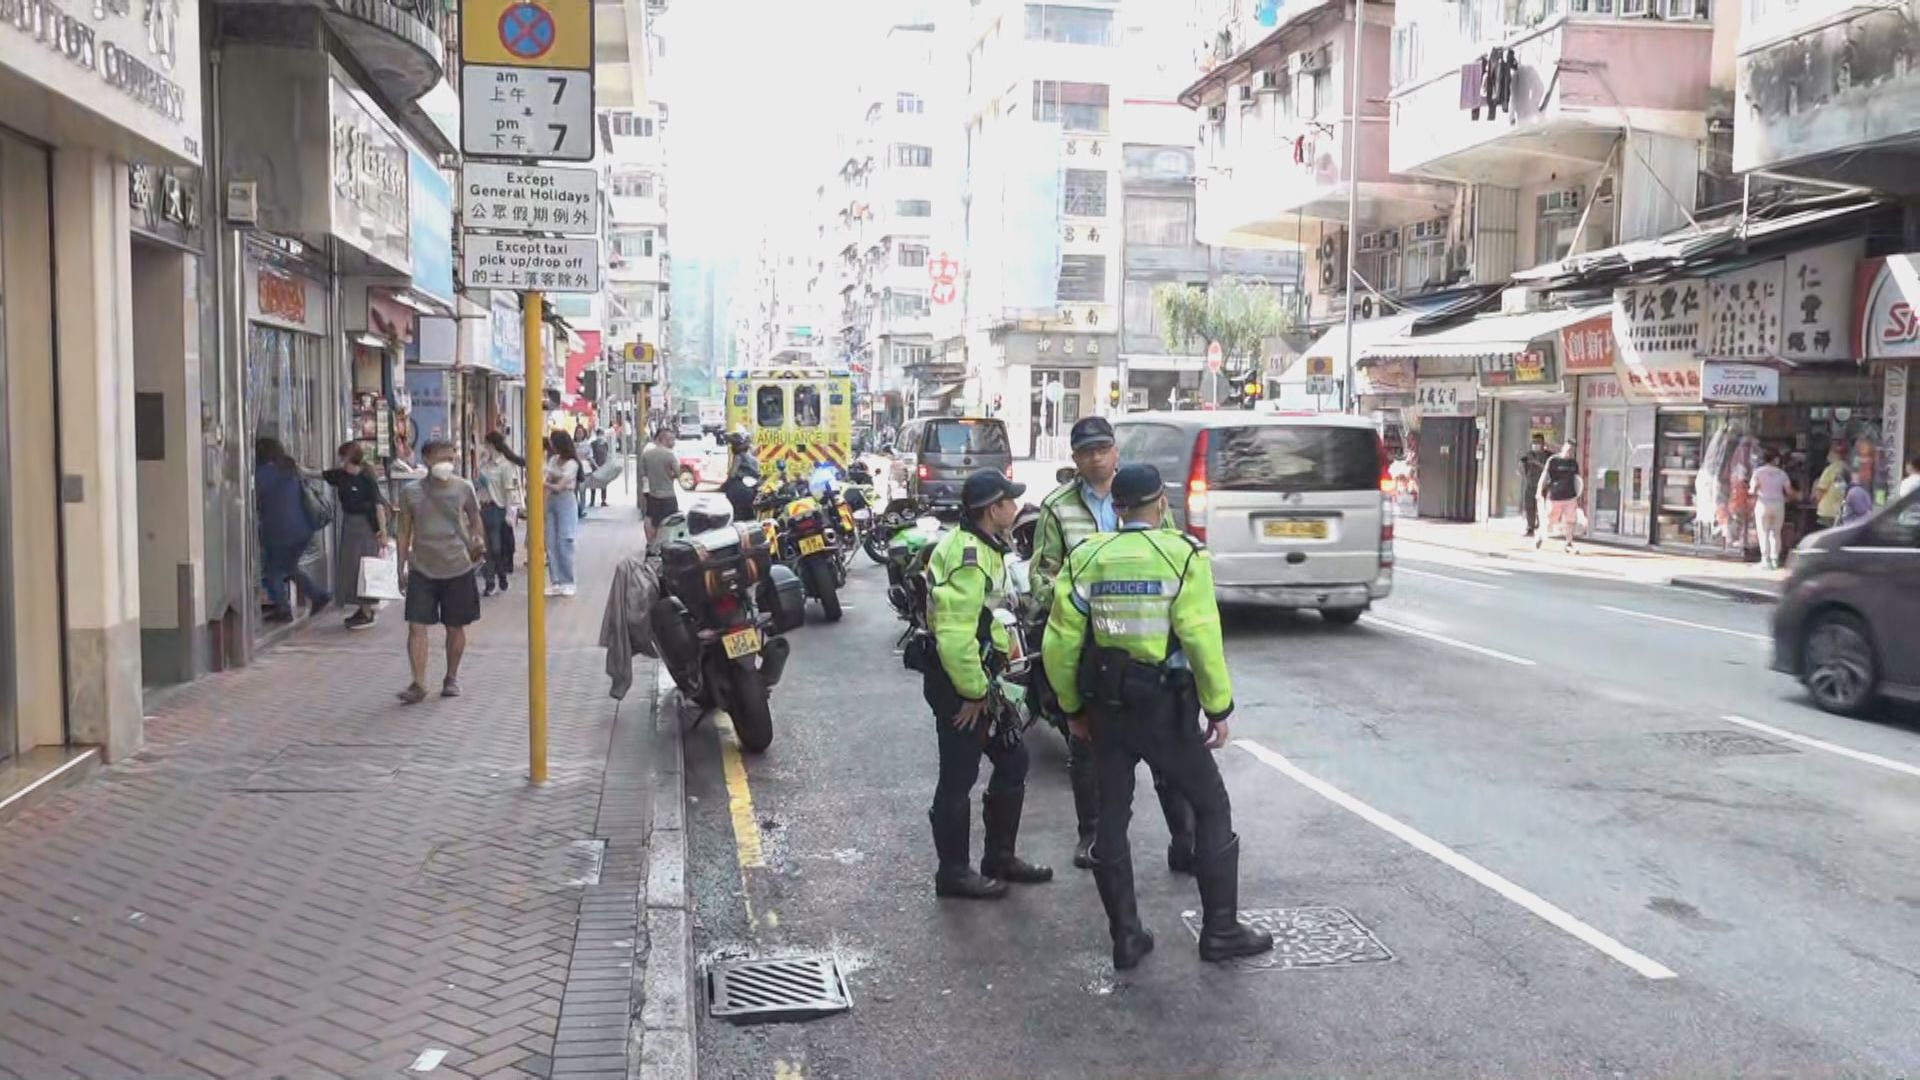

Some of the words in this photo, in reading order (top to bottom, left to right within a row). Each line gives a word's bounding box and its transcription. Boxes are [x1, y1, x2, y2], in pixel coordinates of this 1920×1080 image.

[496, 72, 519, 83] am
[489, 86, 526, 103] 上午
[547, 77, 568, 105] 7
[496, 119, 520, 132] pm
[489, 134, 527, 149] 下午
[547, 124, 568, 152] 7
[507, 172, 555, 187] Except
[470, 184, 526, 199] General
[530, 188, 590, 204] Holidays
[472, 203, 589, 225] 公眾假期例外
[496, 240, 540, 255] Except
[544, 242, 568, 254] taxi
[479, 254, 506, 266] pick
[510, 257, 560, 269] up/drop
[565, 257, 583, 267] off
[472, 270, 589, 288] 的士上落客除外
[1659, 323, 1699, 337] COMPANY
[1711, 383, 1768, 397] SHAZLYN
[757, 430, 823, 445] AMBULANCE
[1102, 581, 1146, 595] POLICE
